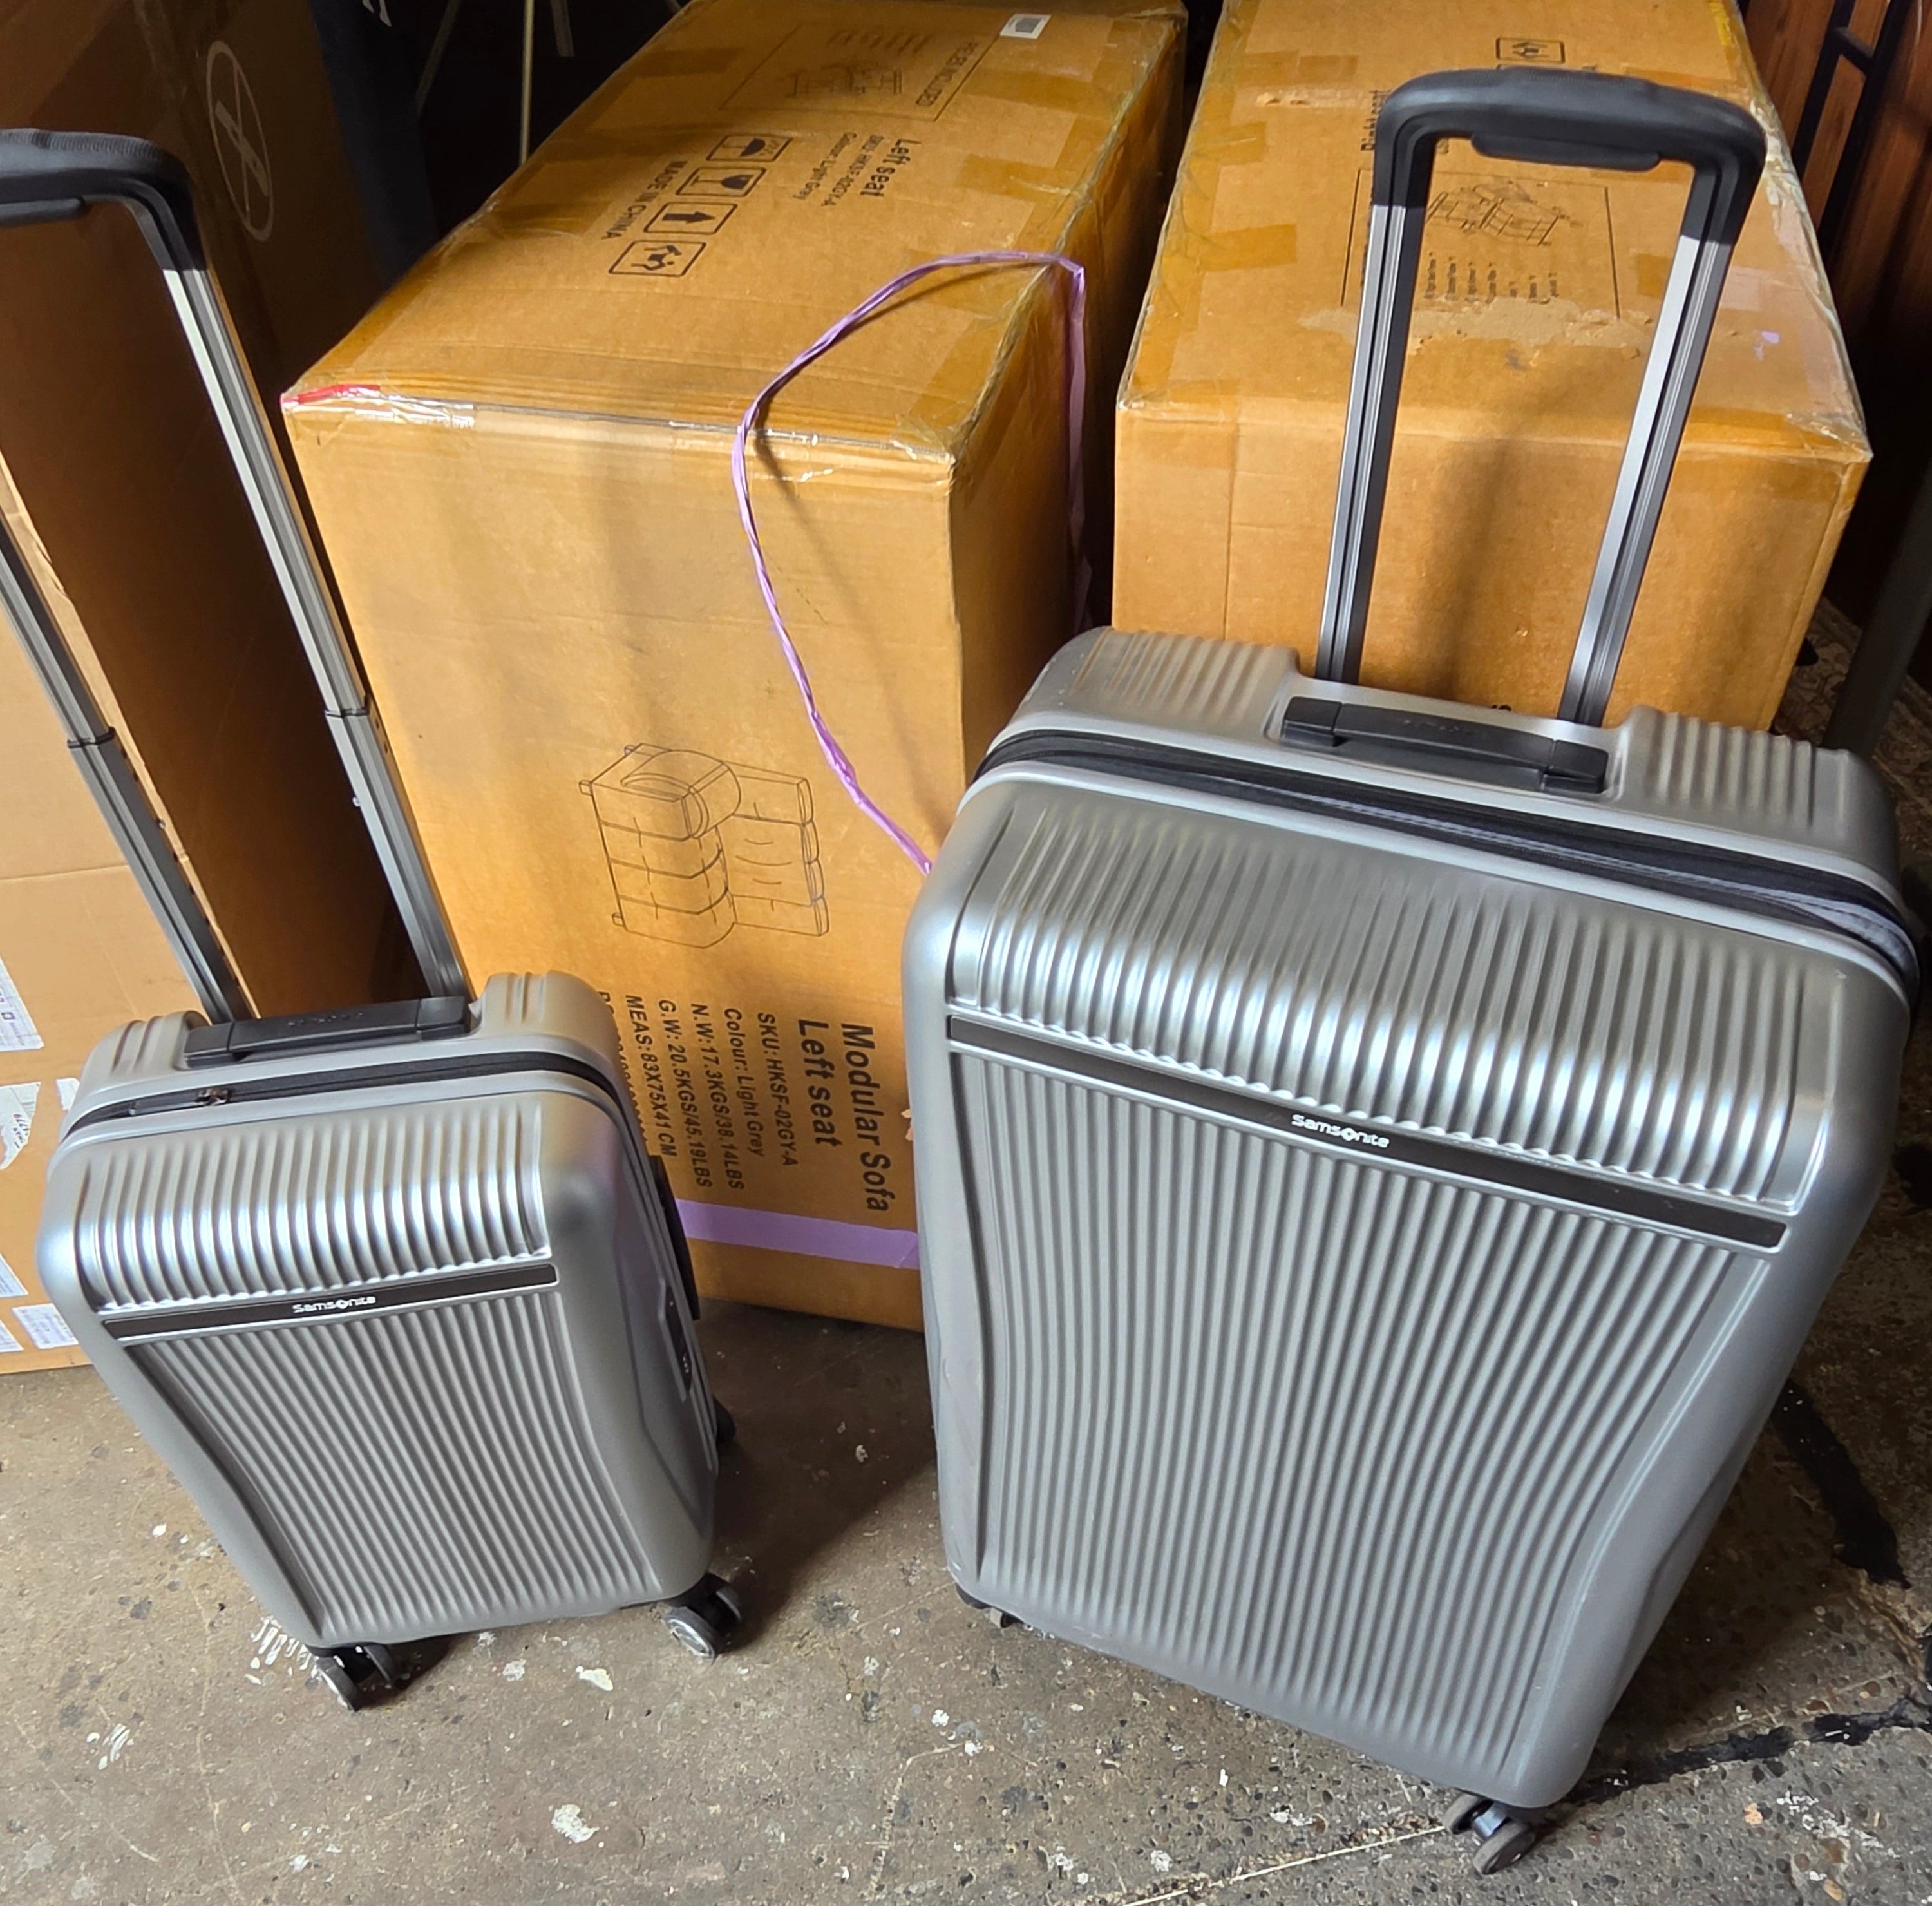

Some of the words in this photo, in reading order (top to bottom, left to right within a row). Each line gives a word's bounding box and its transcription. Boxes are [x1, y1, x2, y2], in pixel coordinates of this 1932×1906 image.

[883, 138, 922, 165] Left
[860, 166, 896, 196] seat
[724, 1008, 749, 1071] Colour:
[798, 1019, 835, 1079] Left
[736, 1075, 761, 1117] Light
[841, 1023, 885, 1147] Modular
[808, 1085, 843, 1147] seat
[1291, 1114, 1390, 1148] Samsonite
[658, 1132, 678, 1157] CM
[747, 1120, 764, 1158] Grey
[860, 1152, 896, 1212] Sofa
[292, 1296, 377, 1313] Samsonite
